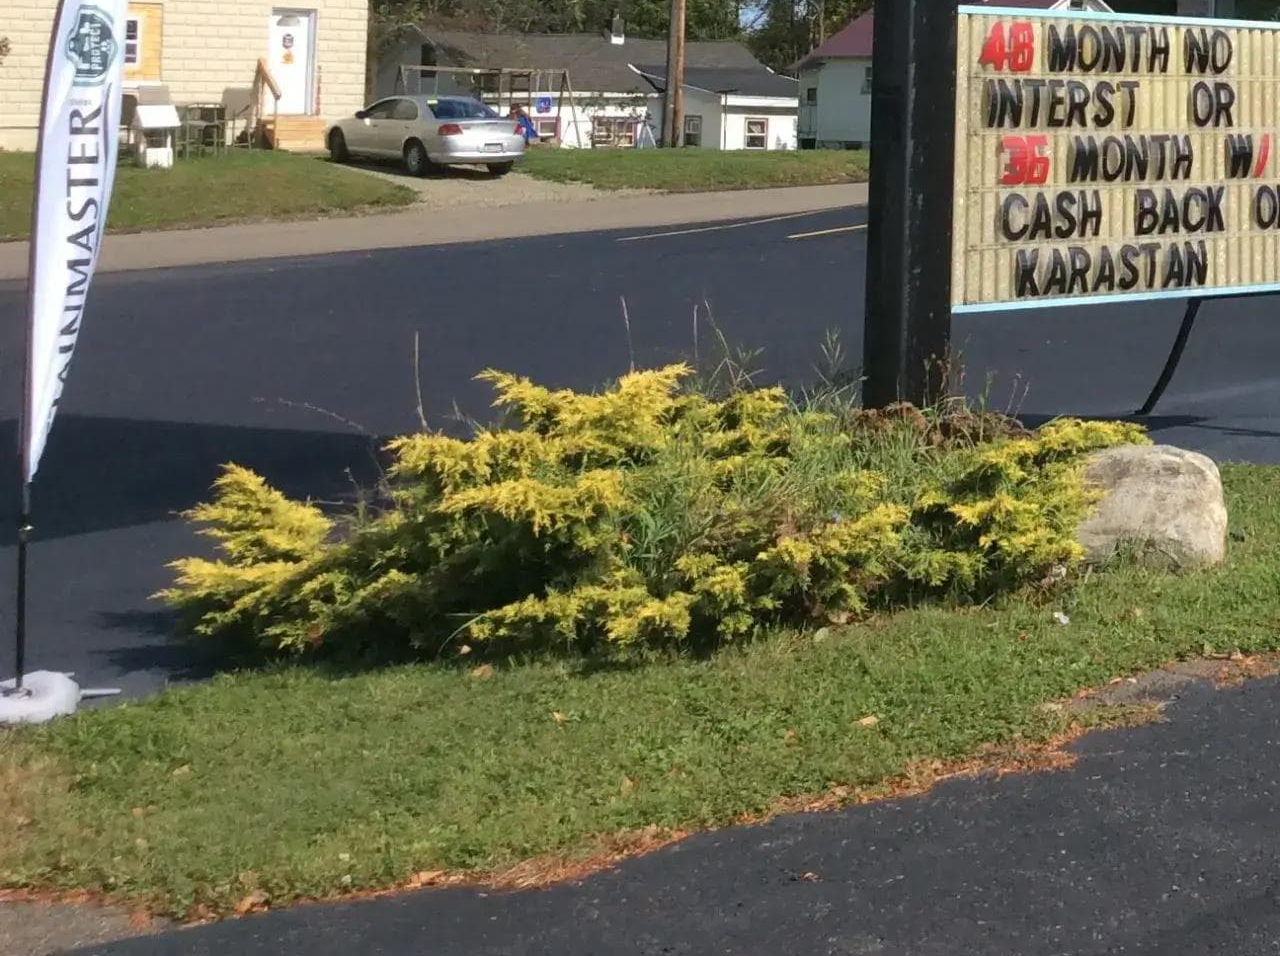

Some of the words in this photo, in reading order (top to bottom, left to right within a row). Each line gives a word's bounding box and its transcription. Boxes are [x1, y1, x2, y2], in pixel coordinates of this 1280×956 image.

[90, 23, 103, 71] PROTECT
[979, 21, 1035, 73] 48
[1047, 23, 1170, 74] MONTH
[1184, 27, 1234, 74] NO
[987, 79, 1140, 128] INTERST
[1192, 81, 1236, 127] OR
[1001, 135, 1050, 185] 36
[1071, 134, 1193, 182] MONTH
[1225, 133, 1270, 179] W/
[1002, 189, 1103, 241] CASH
[1135, 185, 1226, 235] BACK
[1016, 240, 1209, 298] KARASTAN
